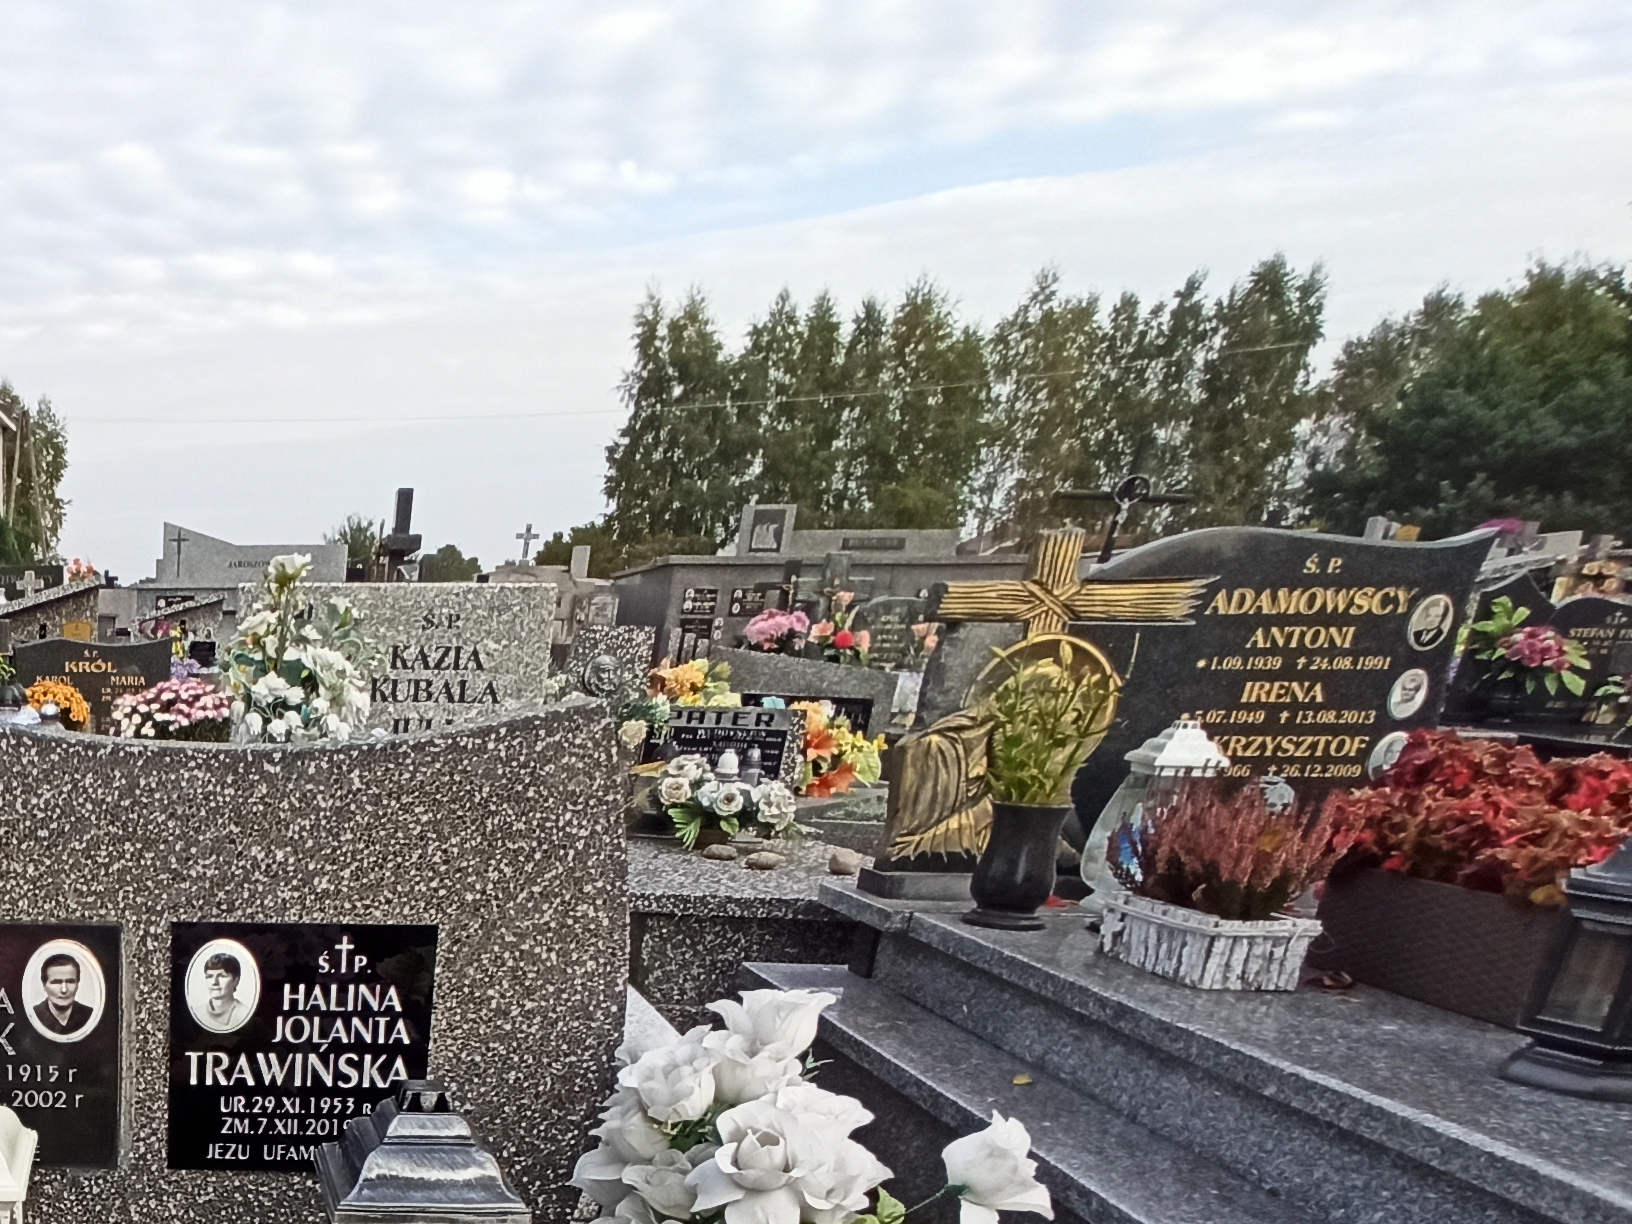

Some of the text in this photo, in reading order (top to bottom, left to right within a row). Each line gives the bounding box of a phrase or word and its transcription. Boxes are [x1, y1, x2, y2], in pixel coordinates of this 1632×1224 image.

[1203, 586, 1420, 616] ADAMOWSCY
[1244, 626, 1356, 649] ANTONI
[64, 658, 118, 673] KRÓL
[389, 644, 486, 672] KAZIA
[36, 674, 146, 686] KAROL MARIA
[370, 675, 501, 705] KUBALA
[1240, 681, 1325, 703] IRENA
[1212, 735, 1370, 757] KRZYSZTOF
[282, 983, 403, 1012] HALINA
[271, 1015, 411, 1045] JOLANTA
[184, 1042, 409, 1089] TRAWIŃSKA
[206, 1143, 315, 1161] JEZU UFAM
